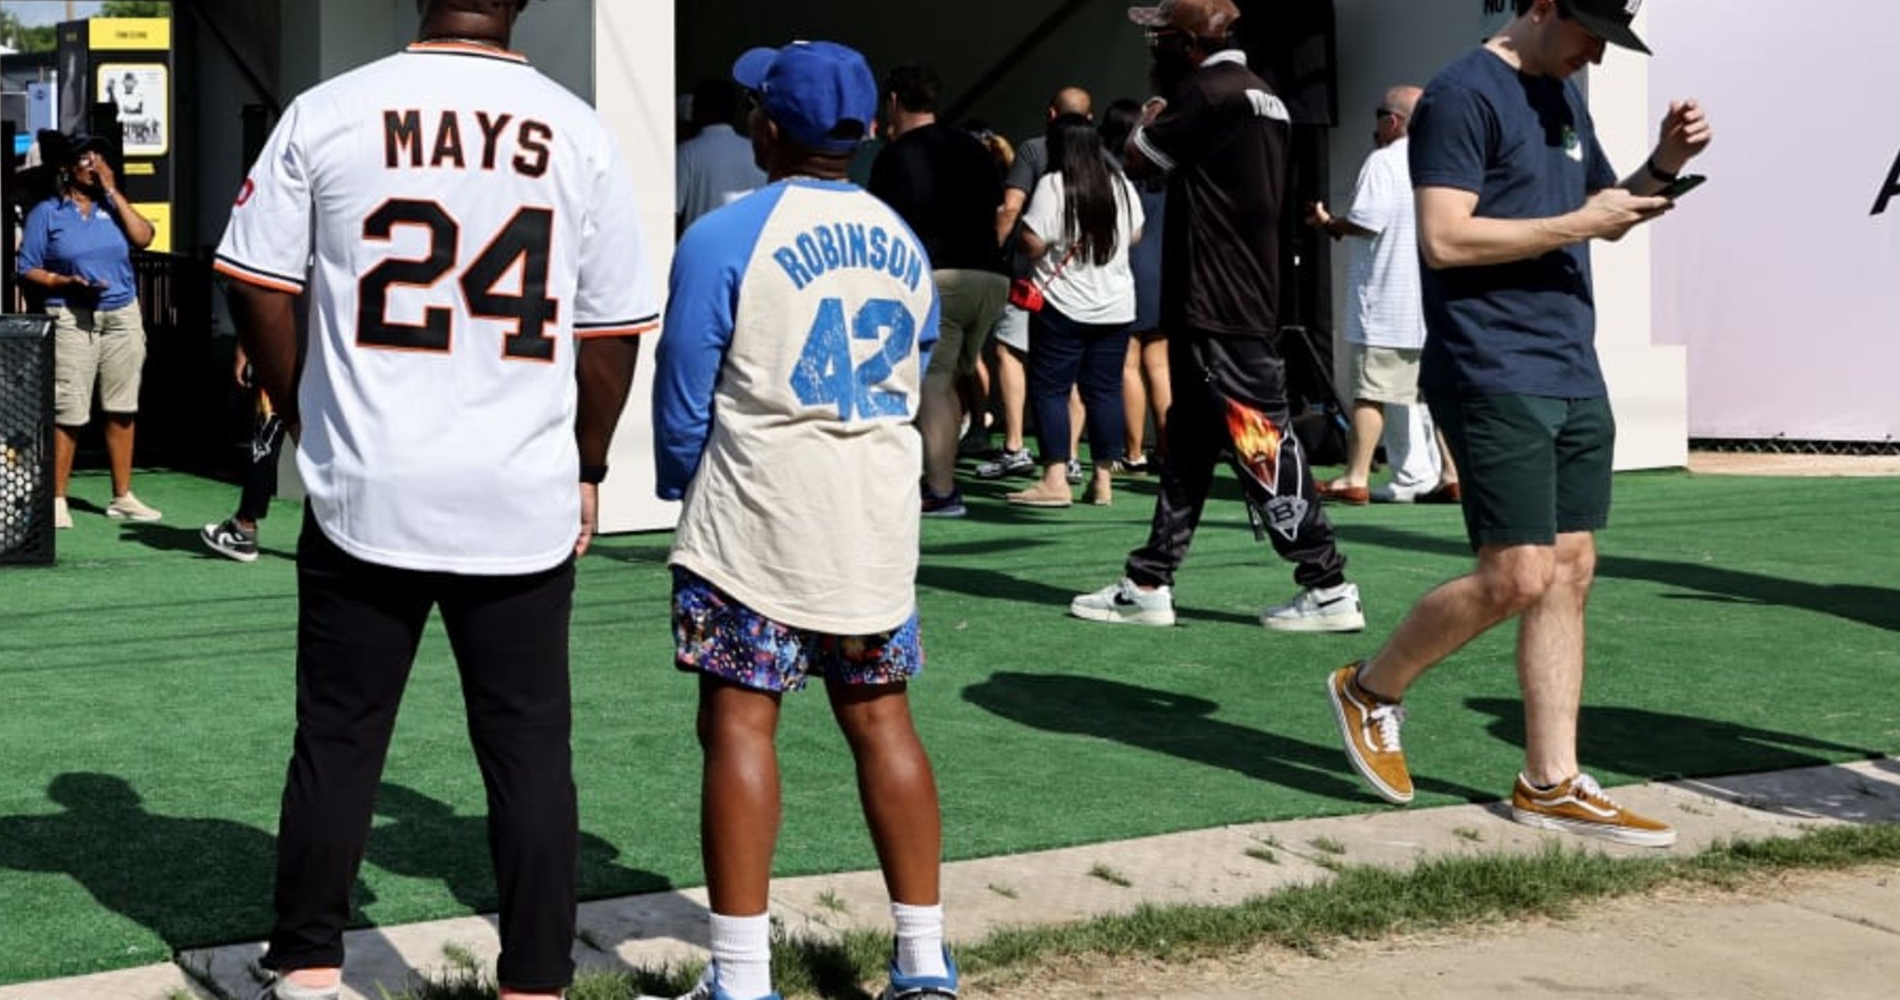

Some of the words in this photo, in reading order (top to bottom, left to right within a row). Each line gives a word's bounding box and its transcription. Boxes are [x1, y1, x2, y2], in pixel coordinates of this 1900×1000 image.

[382, 108, 554, 178] MAYS
[355, 197, 559, 364] 24
[772, 223, 923, 293] ROBINSON
[788, 298, 916, 423] 42
[1271, 502, 1296, 524] B
